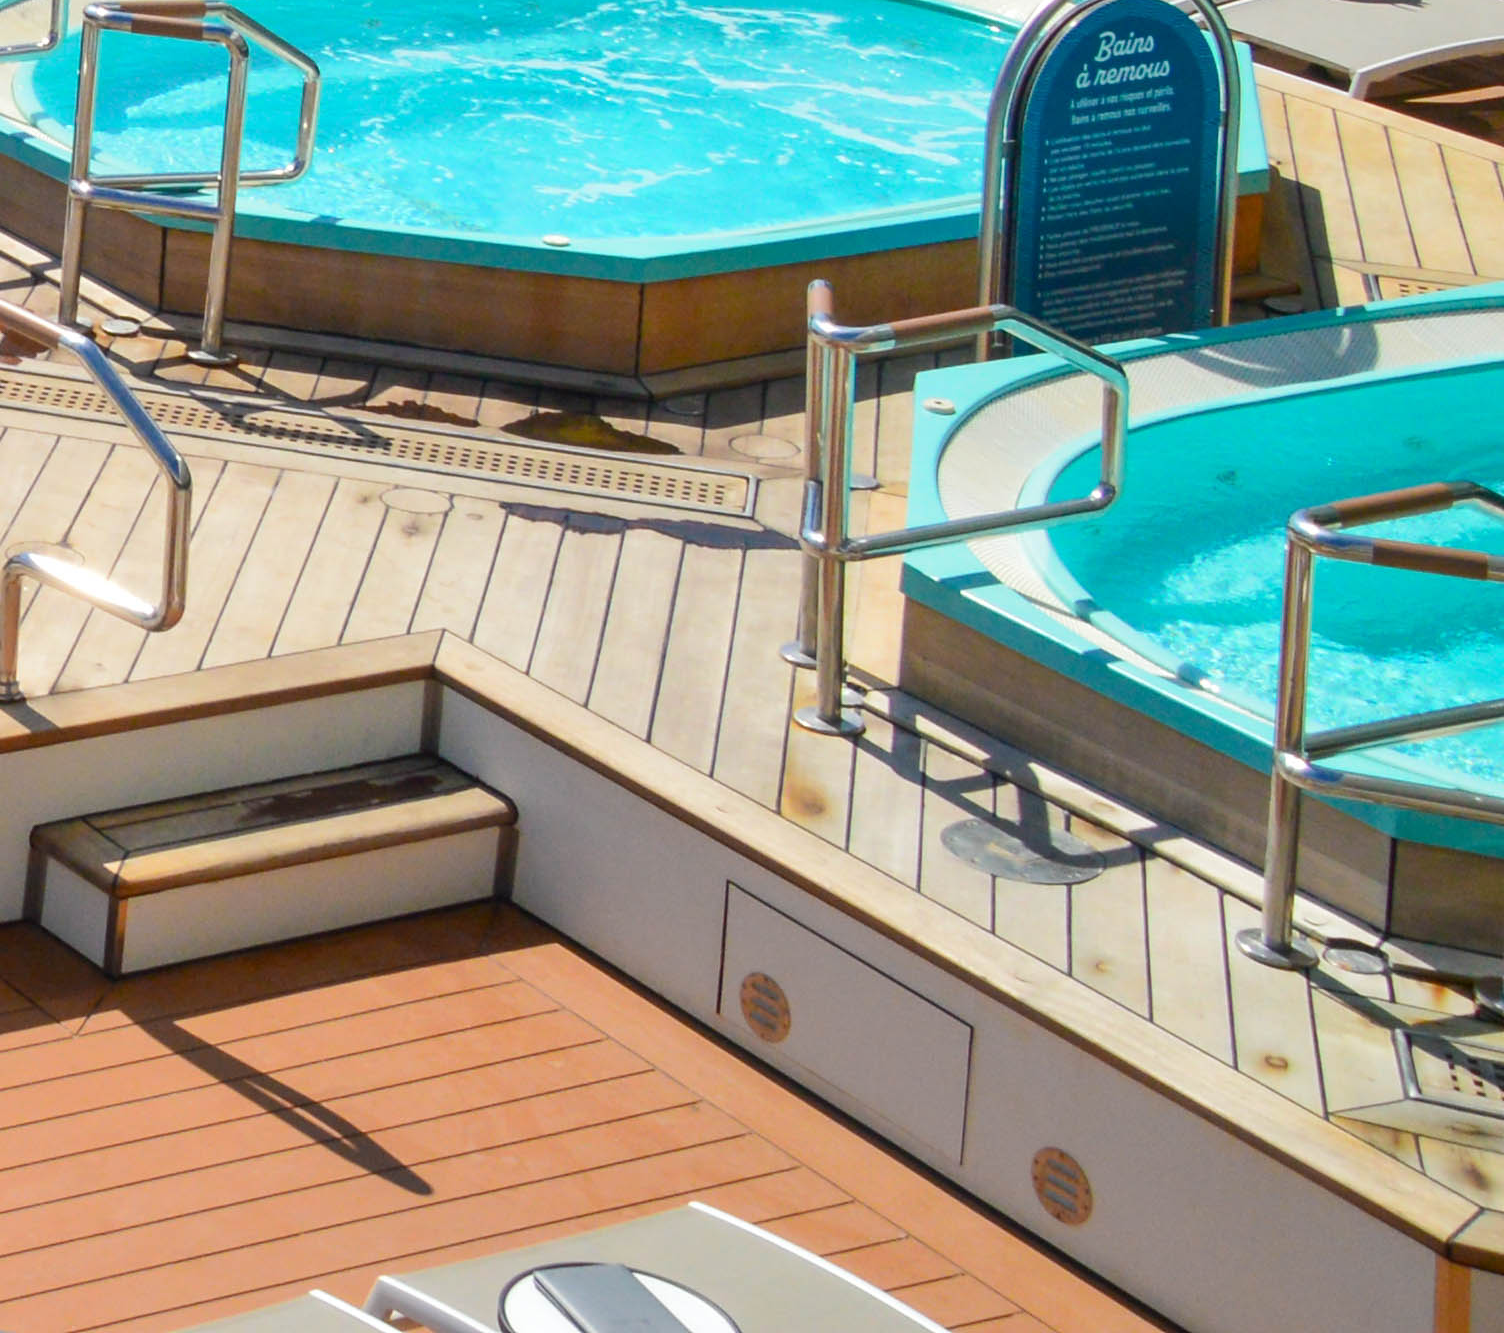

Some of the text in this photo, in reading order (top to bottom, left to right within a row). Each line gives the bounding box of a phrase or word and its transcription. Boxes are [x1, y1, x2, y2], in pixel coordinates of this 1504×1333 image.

[1094, 30, 1155, 62] Bains
[1075, 60, 1170, 90] à remous
